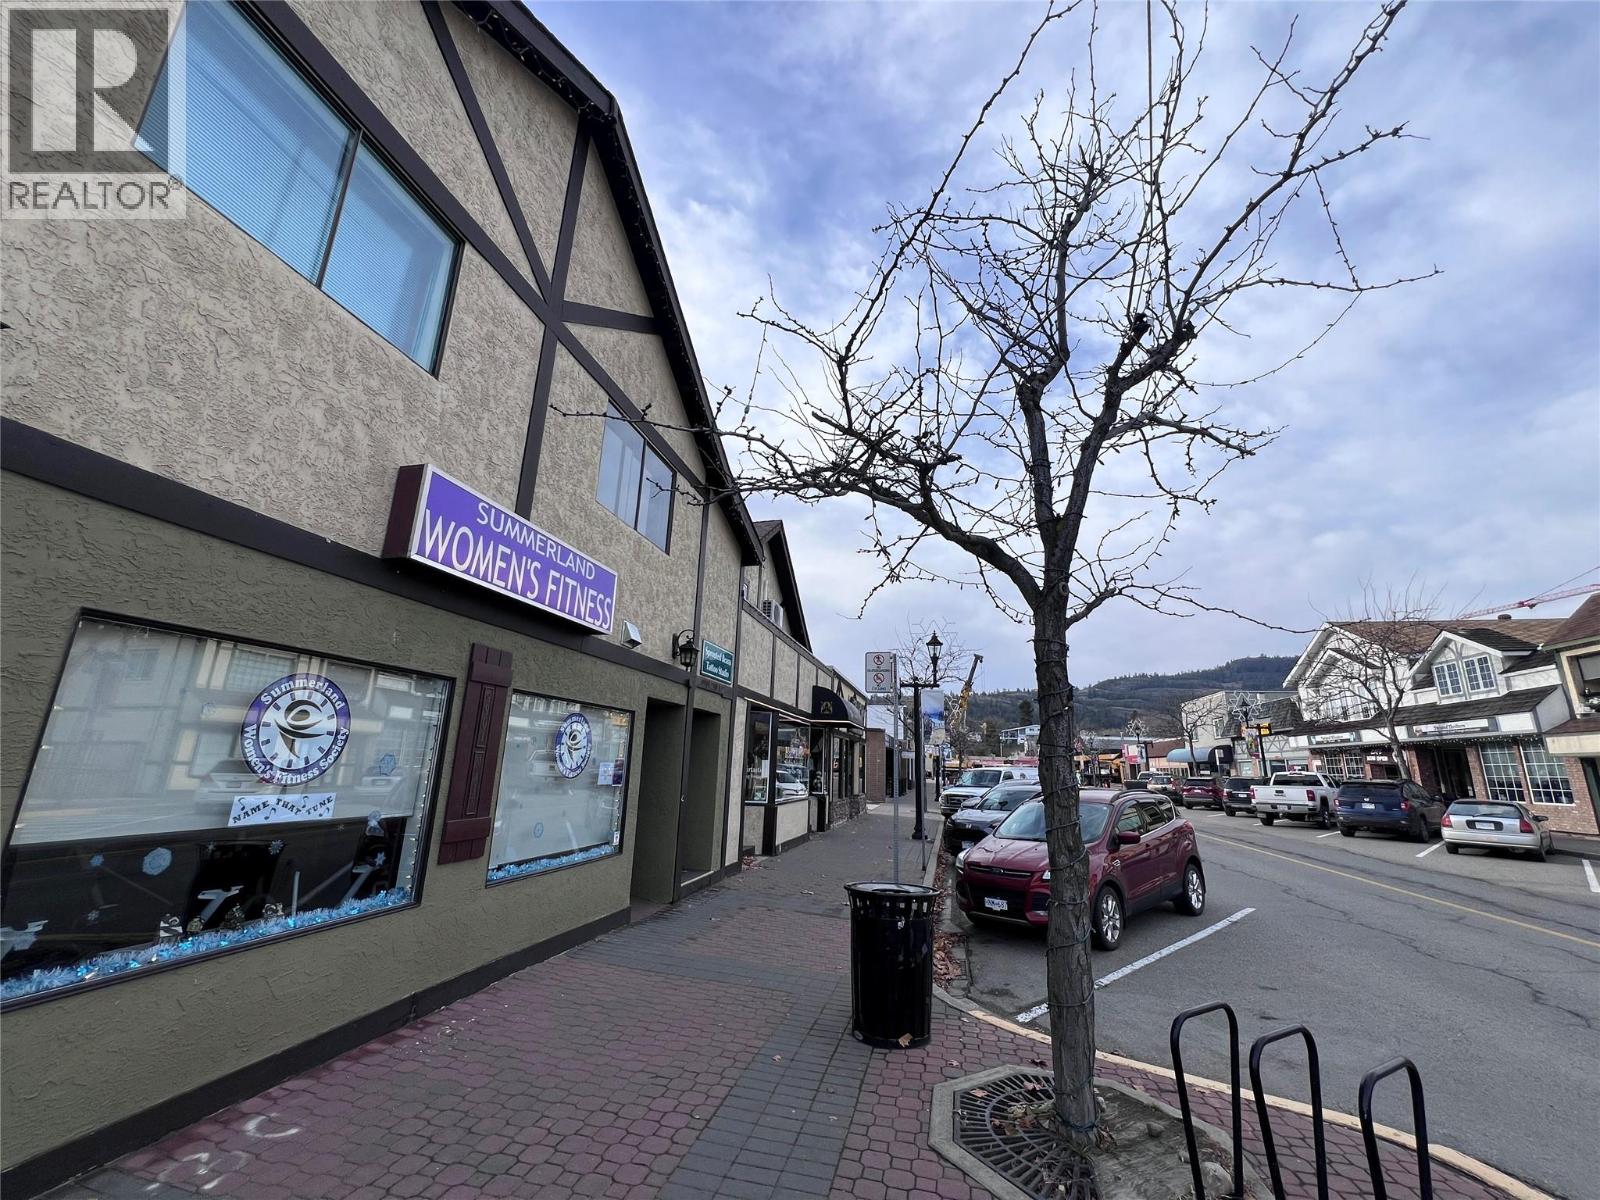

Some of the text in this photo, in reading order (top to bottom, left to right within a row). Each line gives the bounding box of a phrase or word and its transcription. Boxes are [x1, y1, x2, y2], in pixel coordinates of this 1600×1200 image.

[425, 508, 612, 629] WOMEN'S FITNESS
[476, 502, 596, 580] SUMMERLAND
[260, 677, 345, 710] Summerland
[243, 723, 350, 785] Women's Fitness Society
[232, 795, 334, 824] NAME THAT TUNE
